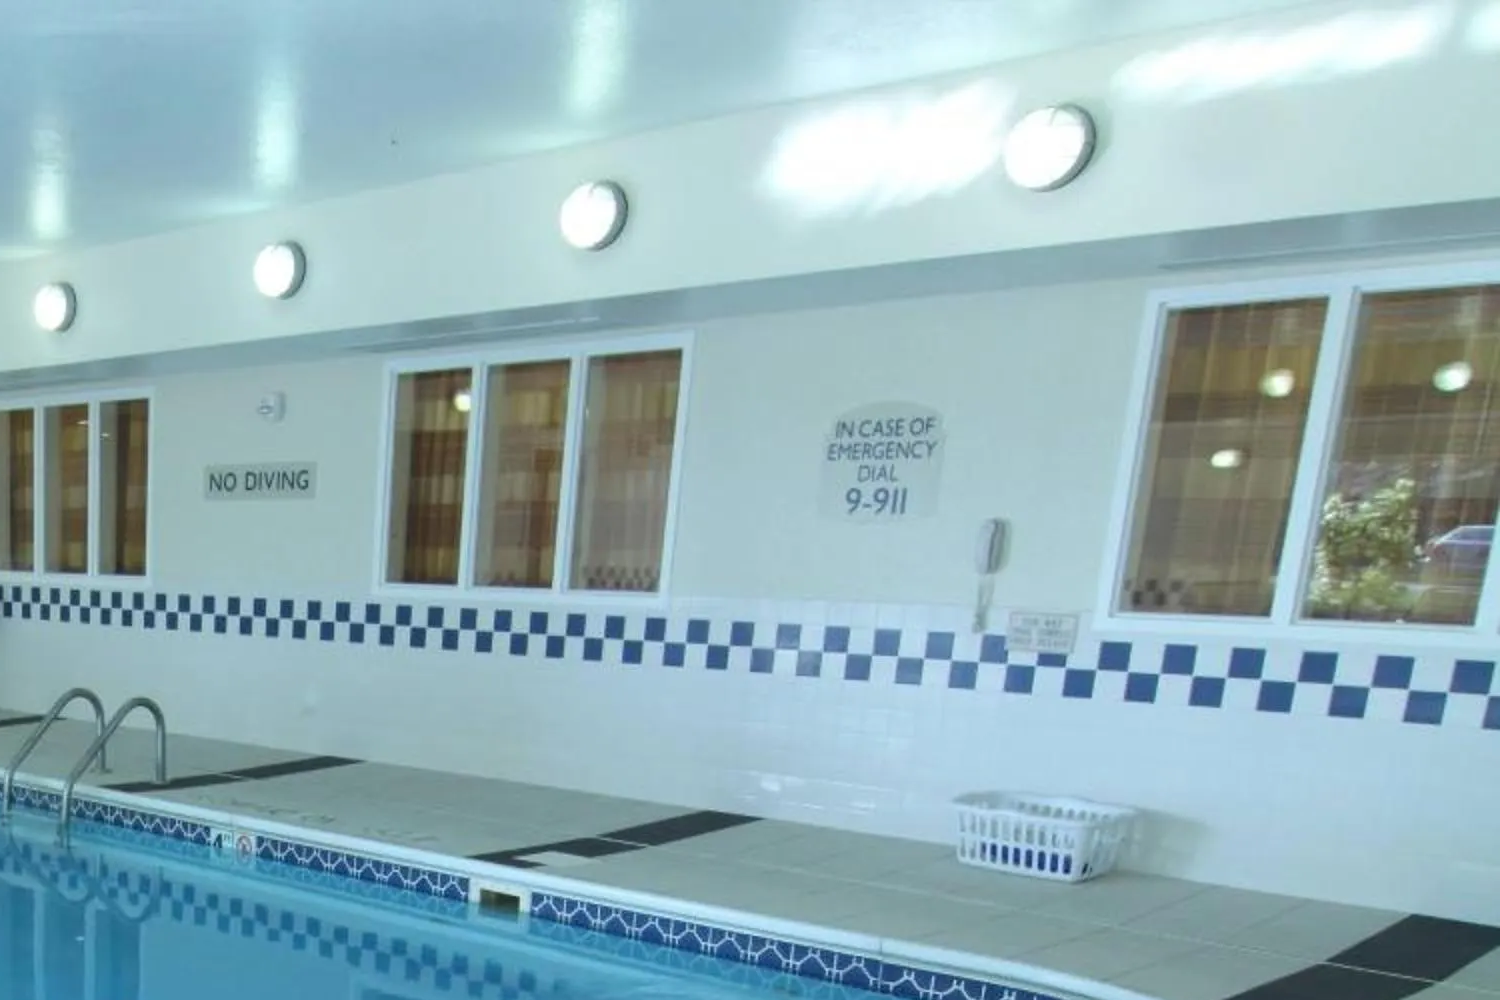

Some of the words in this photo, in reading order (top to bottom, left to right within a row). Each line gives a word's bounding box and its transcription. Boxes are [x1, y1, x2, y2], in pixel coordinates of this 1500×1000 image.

[835, 419, 855, 438] IN
[858, 418, 905, 438] CASE
[909, 416, 937, 437] OF
[826, 440, 939, 461] EMERGENCY
[209, 472, 237, 492] NO
[244, 469, 309, 492] DIVING
[856, 464, 898, 483] DIAL
[845, 487, 908, 515] 9-911
